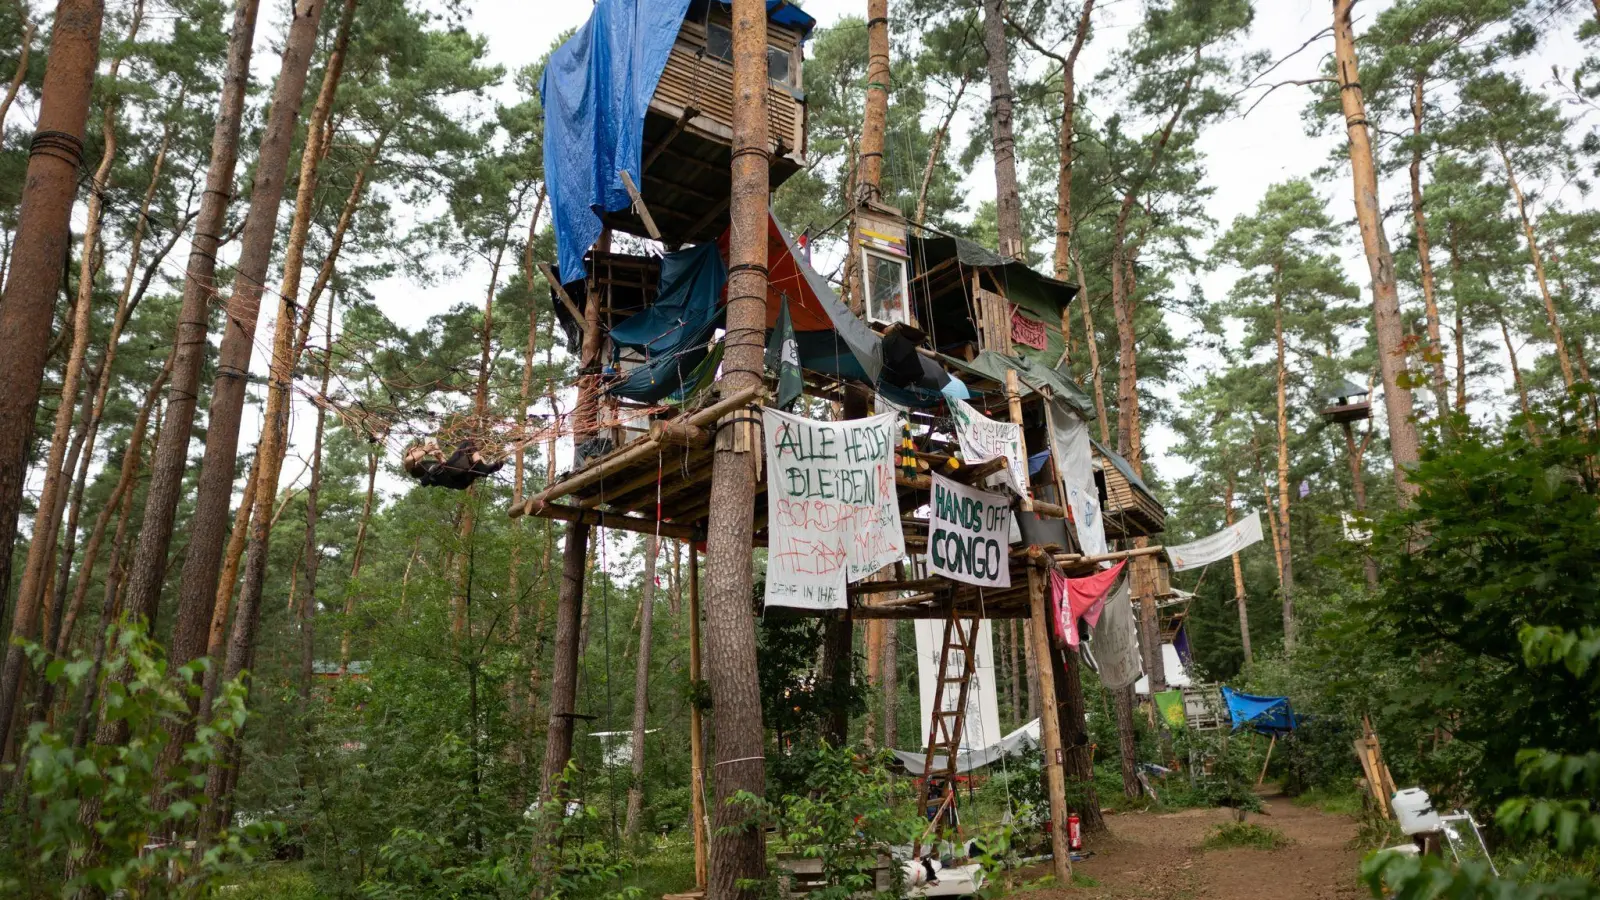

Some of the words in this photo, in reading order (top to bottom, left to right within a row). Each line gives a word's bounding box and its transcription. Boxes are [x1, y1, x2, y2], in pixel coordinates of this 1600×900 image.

[775, 420, 838, 461] ALLE
[935, 483, 983, 532] HANDS
[986, 504, 1008, 531] OFF
[931, 528, 1001, 581] CONGO
